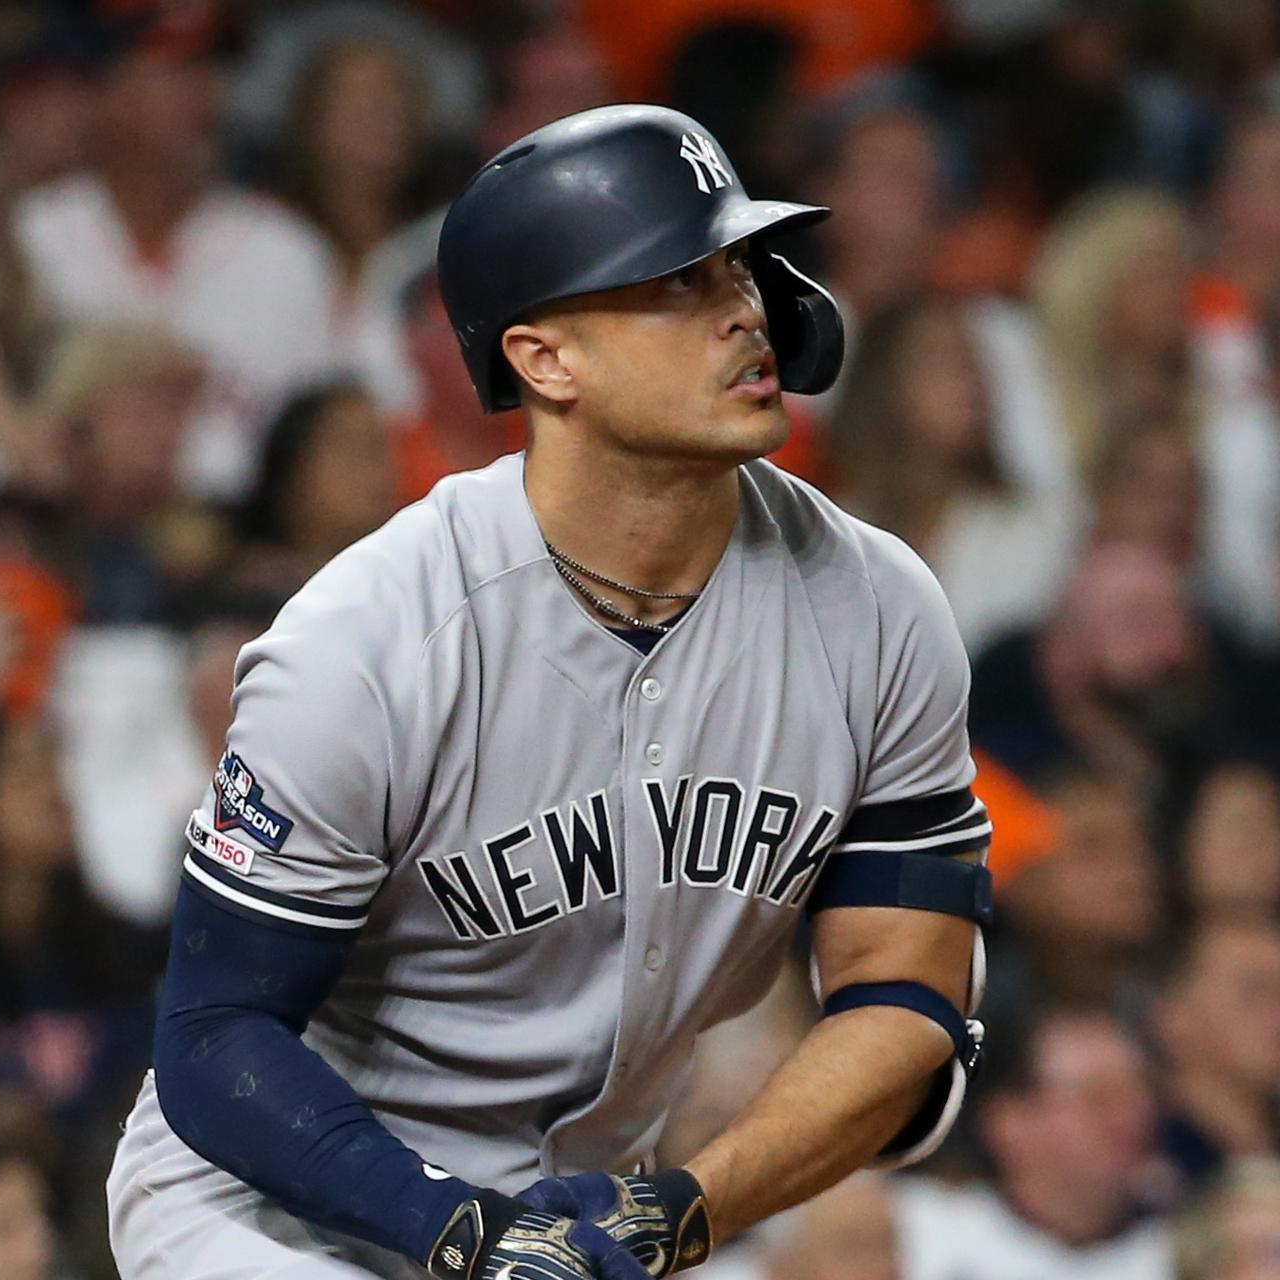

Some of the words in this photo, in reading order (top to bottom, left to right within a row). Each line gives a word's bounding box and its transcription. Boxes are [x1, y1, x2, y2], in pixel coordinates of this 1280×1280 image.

[218, 841, 246, 866] 150
[416, 789, 623, 942] NEW
[641, 775, 840, 907] YORK
